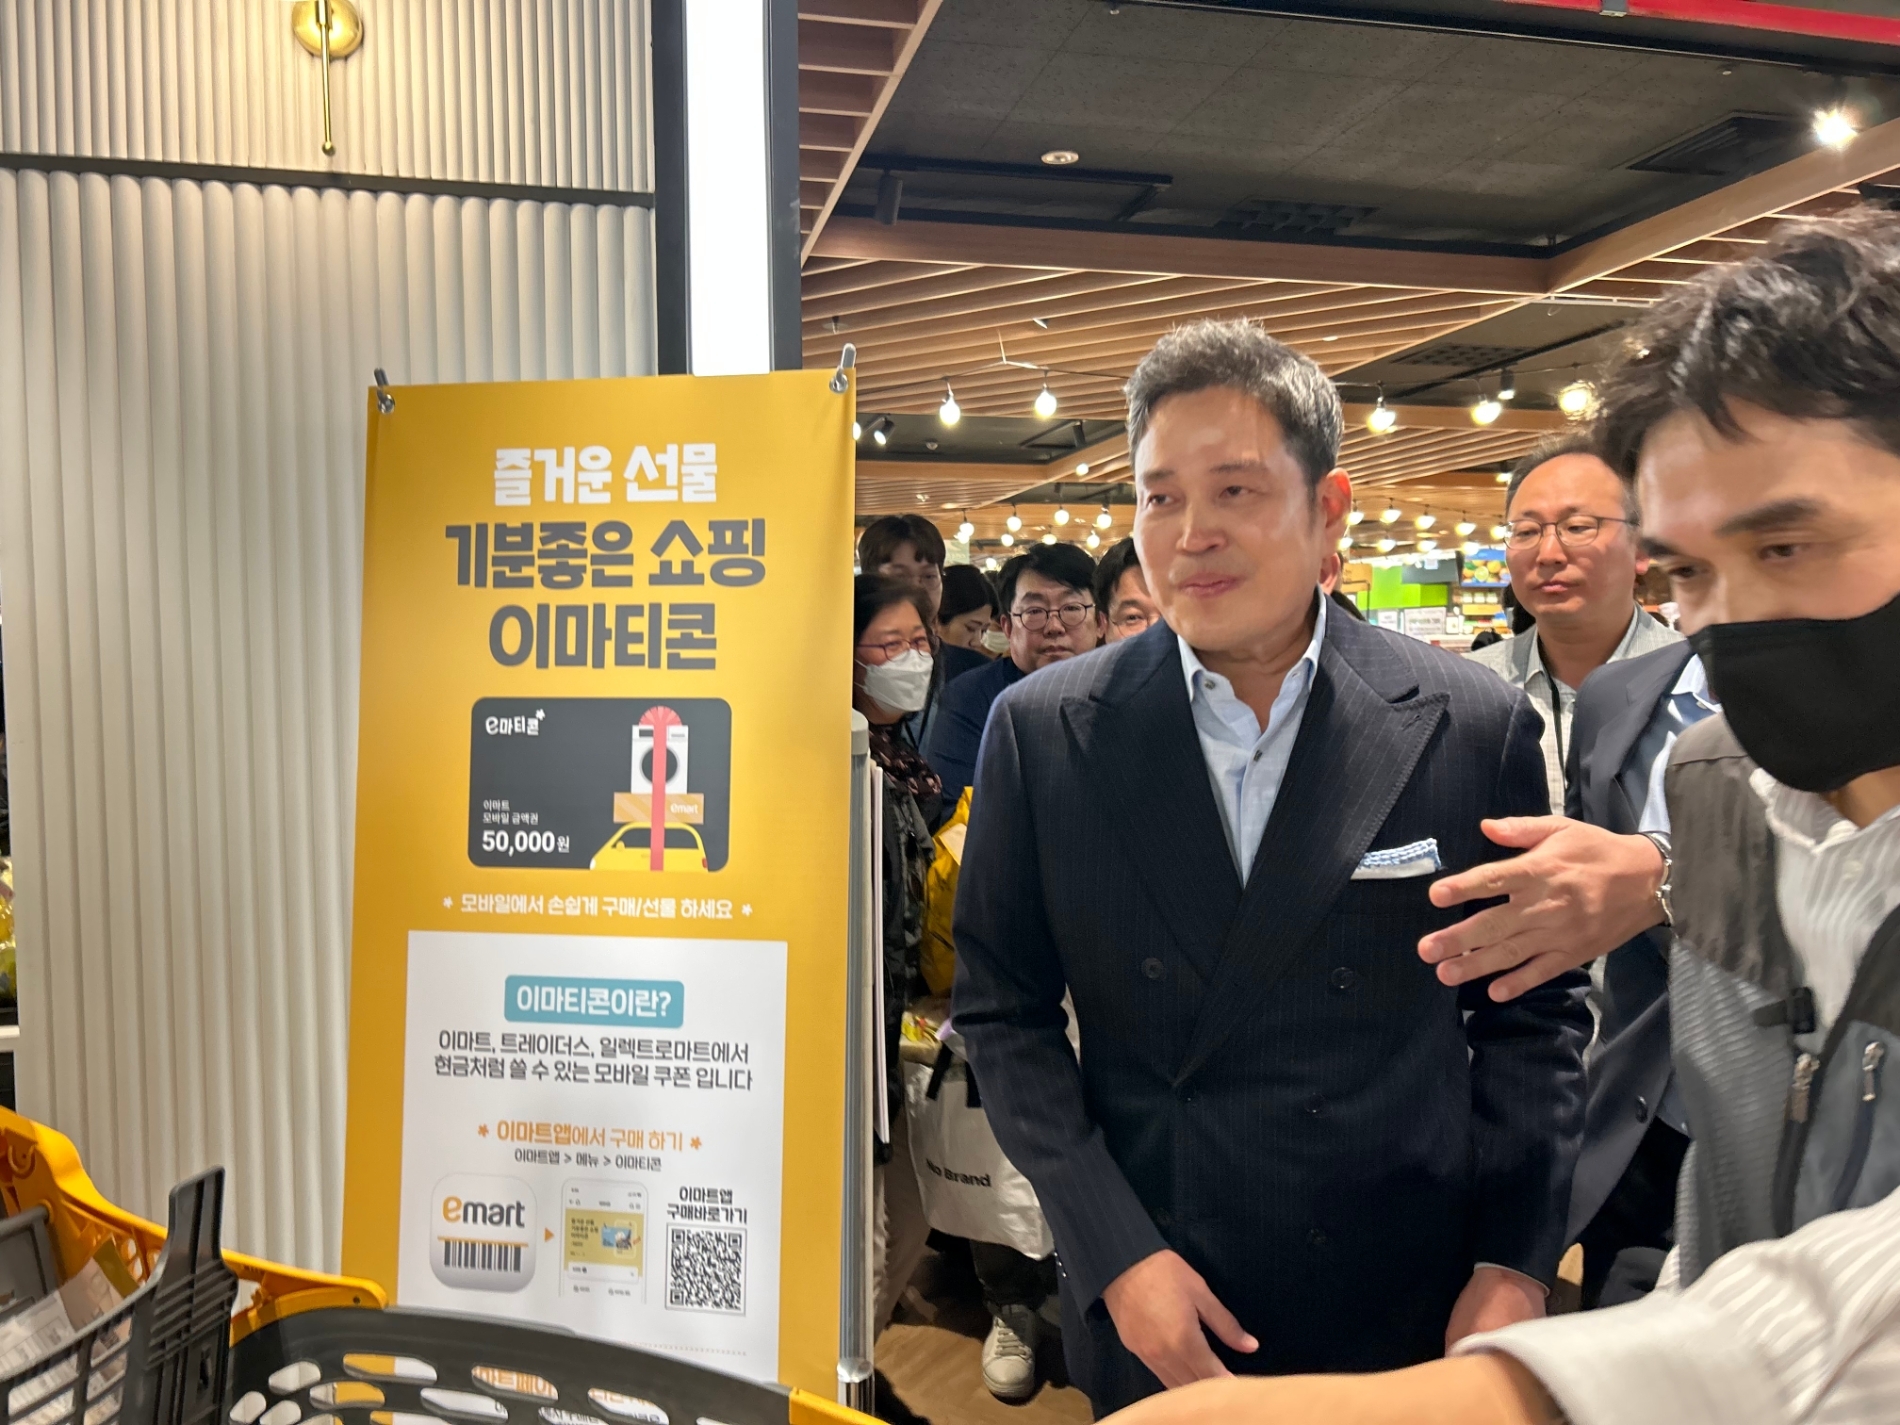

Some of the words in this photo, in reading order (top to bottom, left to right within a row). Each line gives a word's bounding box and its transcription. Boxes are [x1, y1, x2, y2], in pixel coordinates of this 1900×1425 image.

[494, 446, 612, 506] 즐거운
[623, 443, 717, 503] 선물
[445, 520, 634, 590] 기분좋은
[648, 518, 766, 587] 쇼핑
[489, 602, 717, 670] 이마티콘
[482, 812, 509, 825] 모바일
[512, 813, 539, 826] 금액권
[483, 799, 510, 812] 이마트
[670, 803, 698, 815] emart
[482, 830, 570, 857] 50,000원
[461, 894, 544, 915] 모바일에서
[547, 896, 598, 916] 손쉽게
[603, 897, 676, 918] 구매/선물
[681, 898, 733, 919] 하세요
[517, 985, 671, 1018] 이마티콘이란?
[438, 1030, 496, 1055] 이마트,
[500, 1033, 595, 1059] 트레이더스,
[599, 1037, 749, 1065] 일렉트로마트에서
[434, 1054, 505, 1080] 현금처럼
[509, 1059, 527, 1080] 쓸
[531, 1060, 549, 1082] 수
[554, 1060, 590, 1083] 있는
[594, 1063, 649, 1086] 모바일
[653, 1066, 692, 1089] 쿠폰
[696, 1066, 753, 1092] 입니다
[497, 1120, 606, 1149] 이마트앱에서
[610, 1129, 644, 1149] 구매
[648, 1130, 683, 1152] 하기
[514, 1148, 560, 1166] 이마트앱
[576, 1151, 599, 1168] 메뉴
[615, 1155, 662, 1172] 이마티콘
[943, 1166, 991, 1187] Brand
[679, 1186, 733, 1205] 이마트앱
[442, 1196, 525, 1228] emart
[667, 1203, 748, 1225] 구매바로가기
